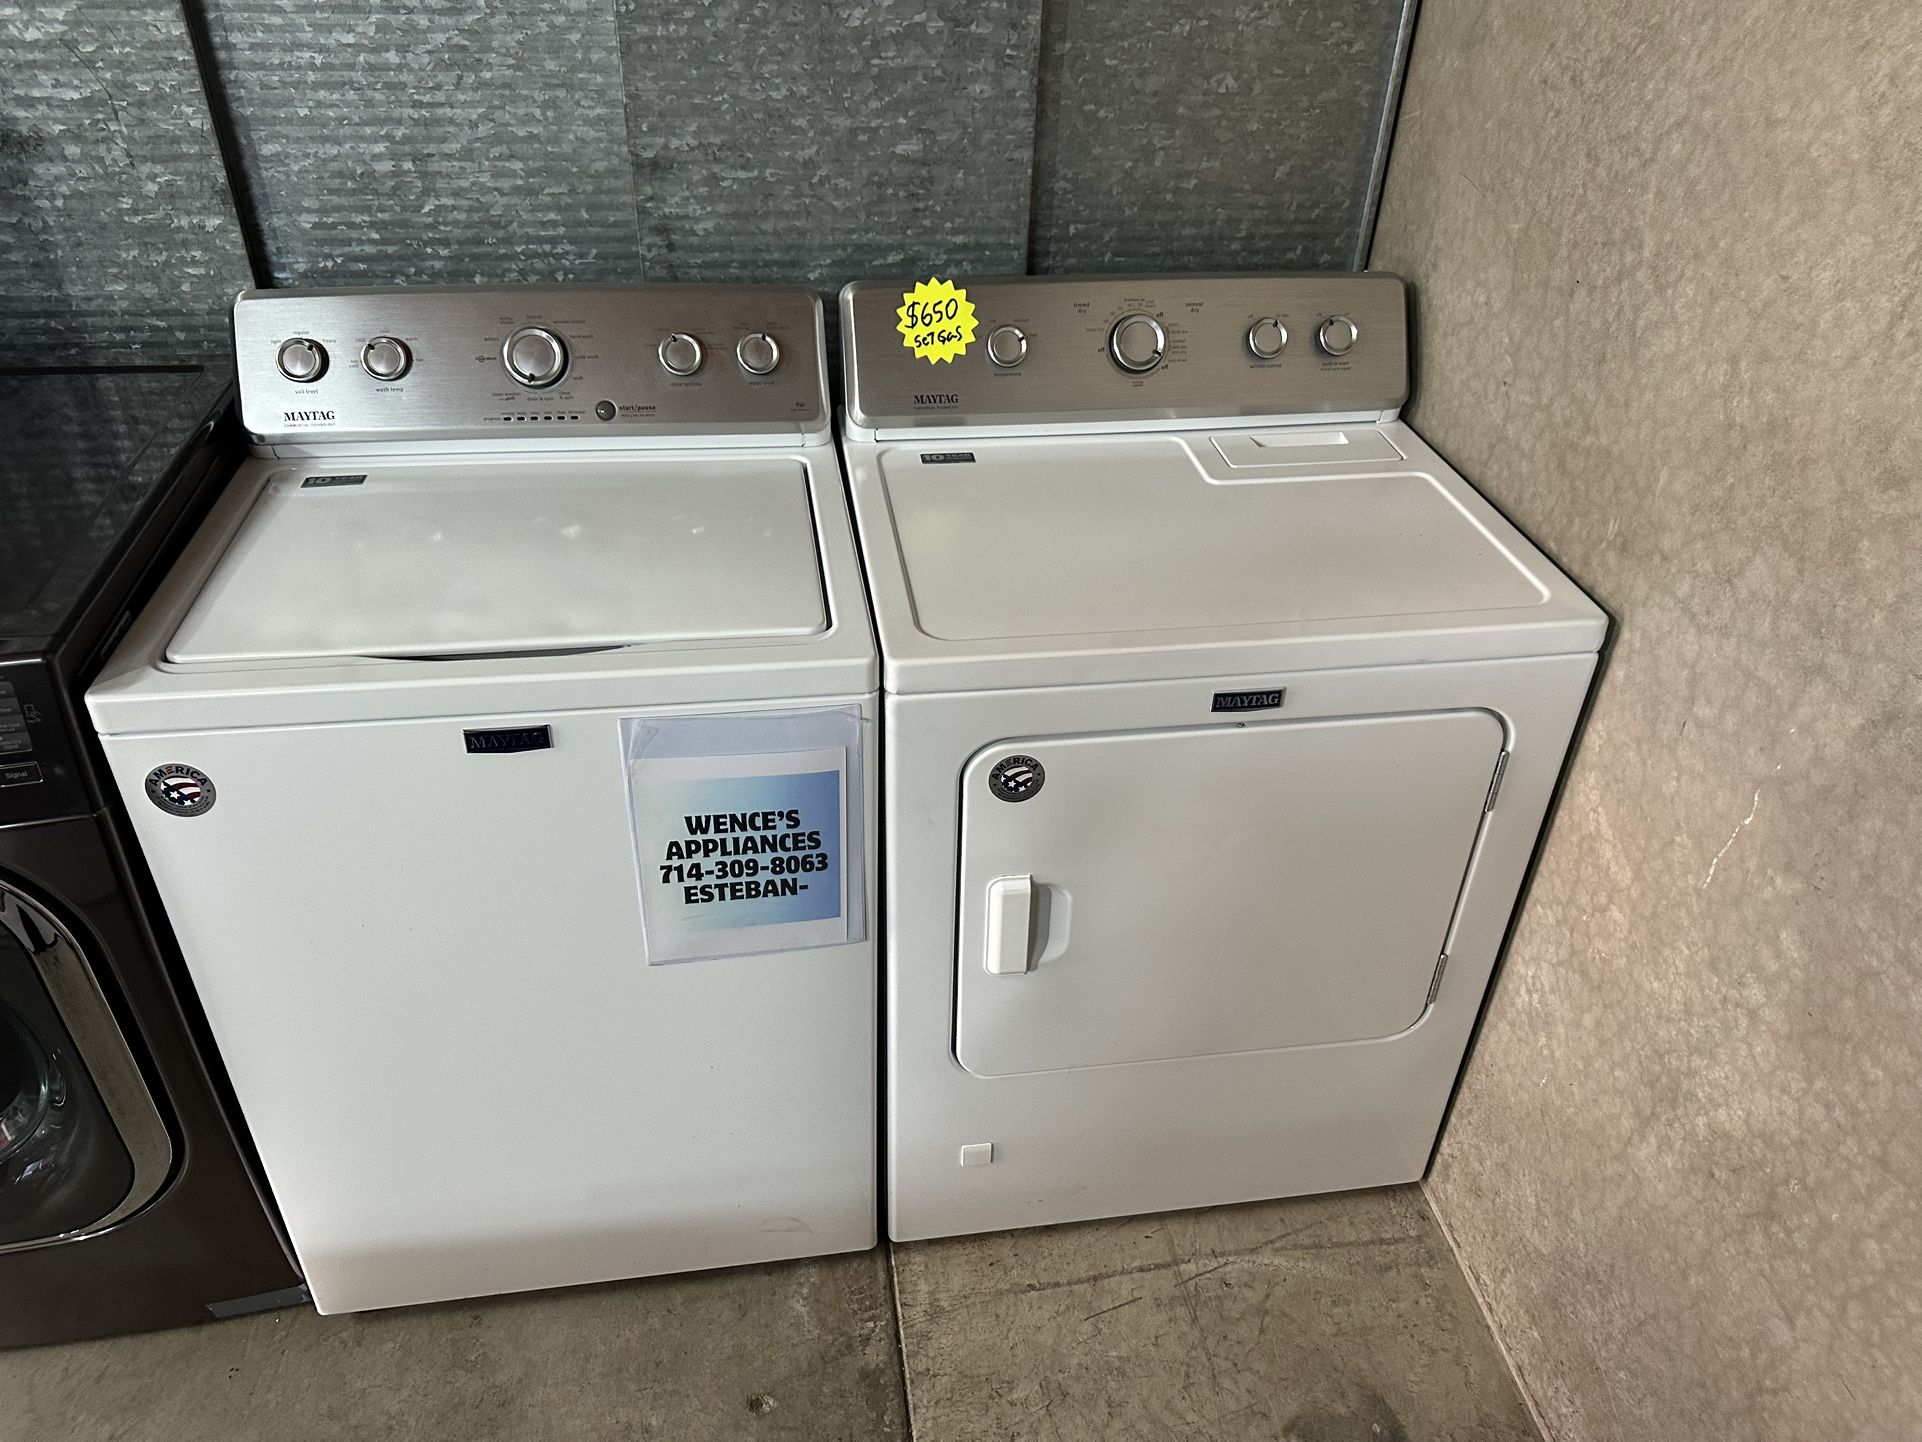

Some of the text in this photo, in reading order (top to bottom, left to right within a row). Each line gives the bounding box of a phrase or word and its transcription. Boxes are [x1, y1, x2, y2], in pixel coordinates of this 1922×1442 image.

[905, 298, 958, 329] $650
[914, 394, 959, 405] MAYTAG
[283, 410, 336, 422] MAYTAG
[1215, 693, 1279, 708] MAYTAG
[469, 732, 546, 749] MAYTAG
[5, 770, 28, 779] Signal
[149, 765, 208, 787] AMERICA
[992, 757, 1039, 780] AMERICA
[684, 809, 801, 836] WENCE'S
[665, 830, 822, 861] APPLIANCES
[659, 853, 829, 884] 714-309-8063
[683, 877, 809, 905] ESTEBAN-
